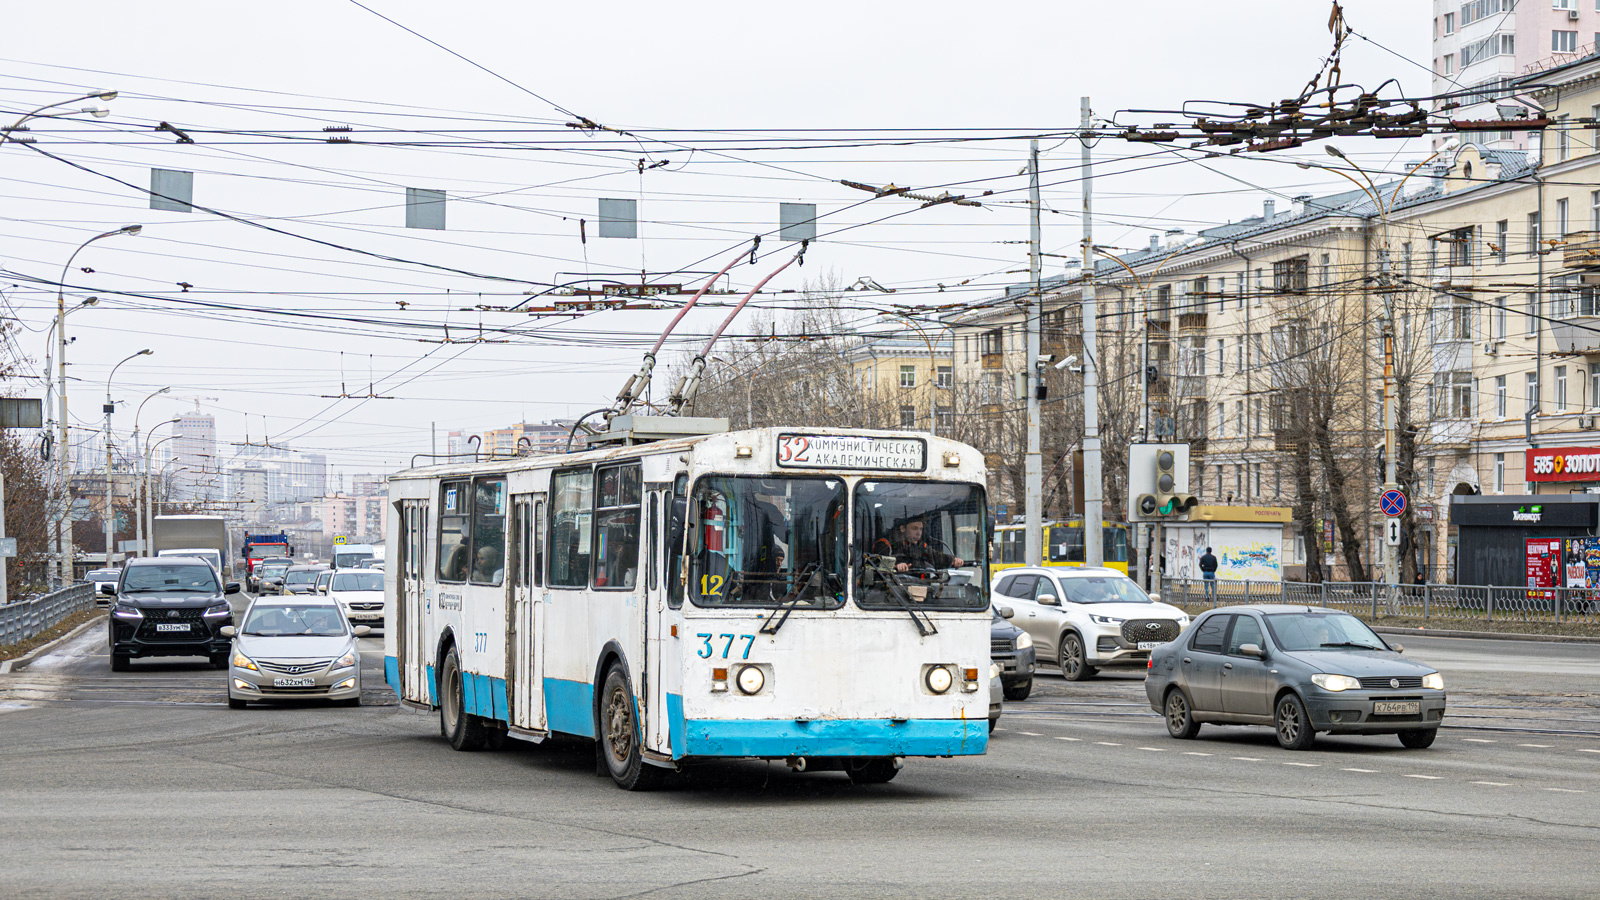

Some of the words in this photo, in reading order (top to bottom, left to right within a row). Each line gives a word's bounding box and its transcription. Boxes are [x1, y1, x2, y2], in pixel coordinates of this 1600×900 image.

[779, 437, 809, 462] 32
[808, 438, 922, 455] КОММУНИСТИЧЕСКАЯ
[815, 453, 916, 469] АКАДЕМИЧЕСКАЯ
[1533, 455, 1554, 474] 585
[447, 491, 457, 509] 377
[700, 574, 724, 597] 12
[474, 632, 488, 653] 377
[696, 632, 756, 660] 377
